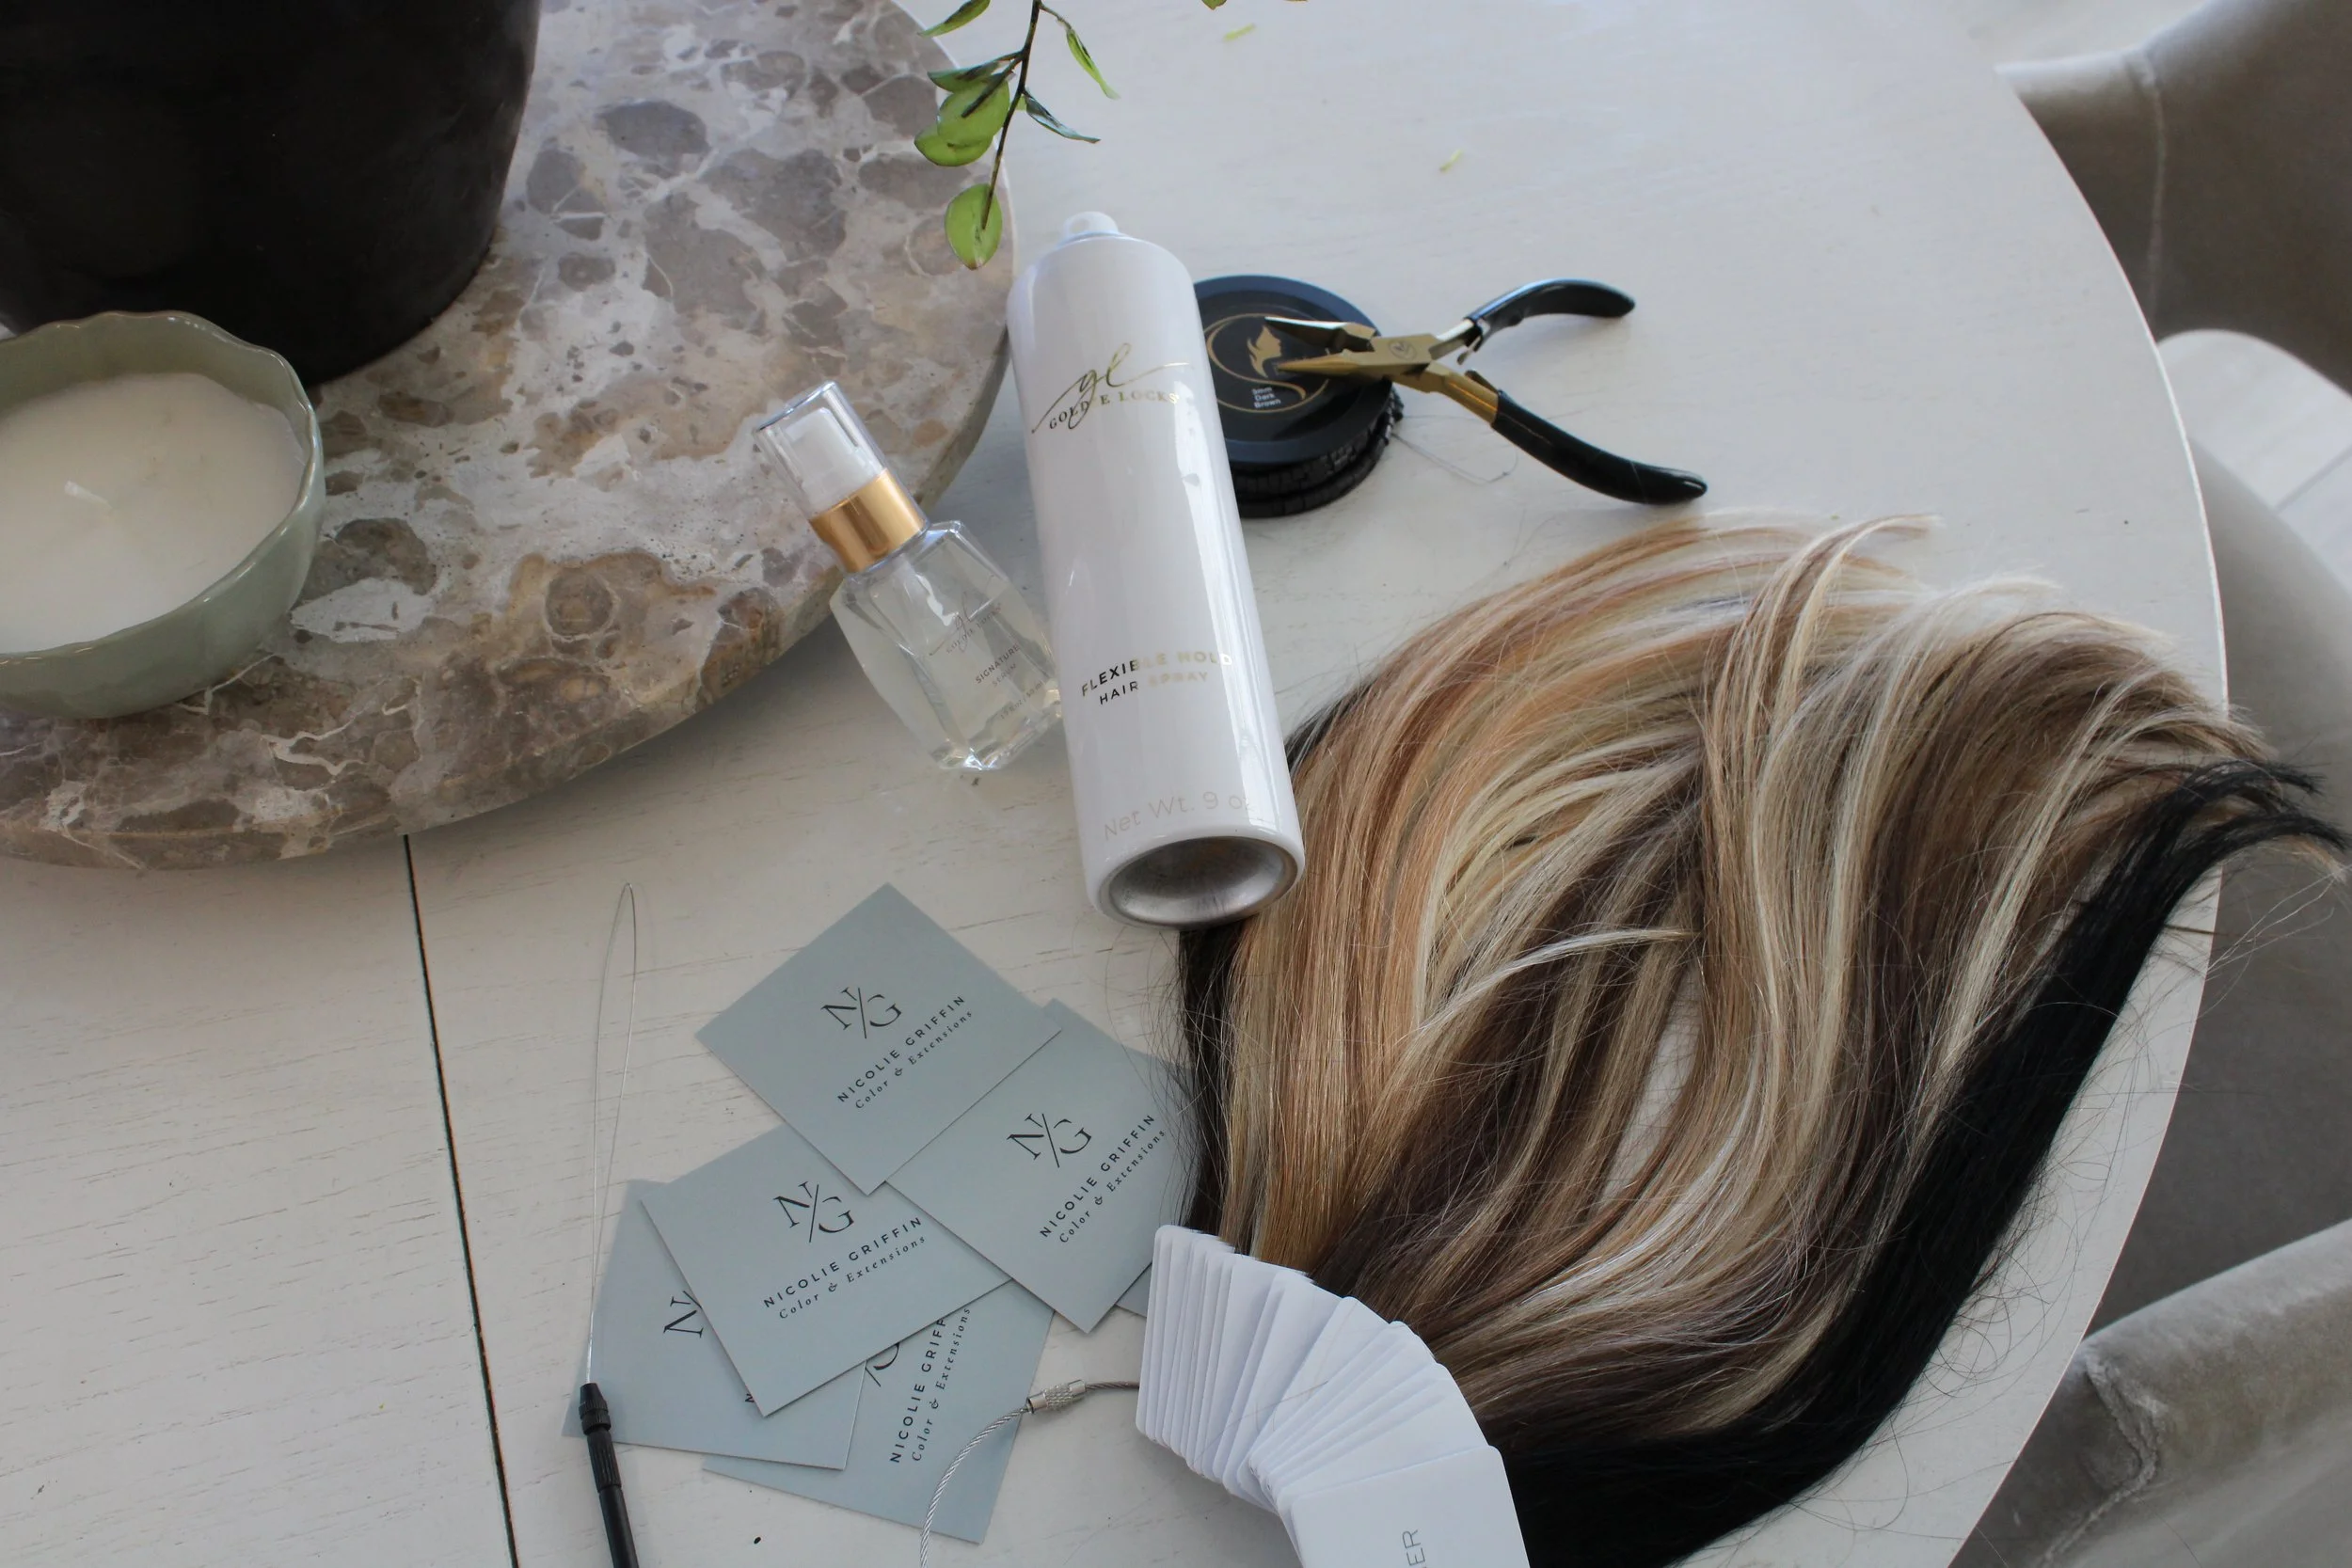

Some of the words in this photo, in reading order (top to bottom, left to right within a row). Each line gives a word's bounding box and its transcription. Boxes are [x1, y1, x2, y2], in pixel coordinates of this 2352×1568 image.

[1118, 389, 1181, 404] LOCKS
[1254, 393, 1276, 402] Dark
[1254, 399, 1281, 408] Brown
[975, 641, 1020, 685] SIGNATURE
[991, 662, 1017, 688] SERUM
[1082, 651, 1168, 697] FLEXIBLE
[1177, 650, 1233, 667] HOLD
[1098, 680, 1140, 705] HAIR
[1147, 671, 1209, 688] SPRAY
[1103, 809, 1142, 842] Net
[1147, 795, 1196, 821] Wt.
[1201, 790, 1220, 811] 9
[837, 1049, 900, 1102] NICOLIE
[904, 995, 965, 1047] GRIFFIN
[854, 1079, 889, 1109] Color
[894, 1067, 903, 1077] &
[907, 1010, 973, 1065] Extensions
[1039, 1176, 1097, 1238] NICOLIE
[1100, 1115, 1155, 1172] GRIFFIN
[1059, 1210, 1091, 1243] Color
[1094, 1196, 1104, 1206] &
[1105, 1129, 1165, 1192] Extensions
[763, 1260, 840, 1308] NICOLIE
[849, 1216, 922, 1262] GRIFFIN
[779, 1293, 819, 1319] Color
[828, 1282, 837, 1292] &
[846, 1235, 926, 1284] Extensions
[889, 1383, 926, 1464] NICOLIE
[920, 1317, 947, 1373] GRIFF
[912, 1418, 934, 1462] Color
[929, 1398, 940, 1410] &
[935, 1307, 972, 1390] Extensions
[1402, 1528, 1427, 1568] ER
